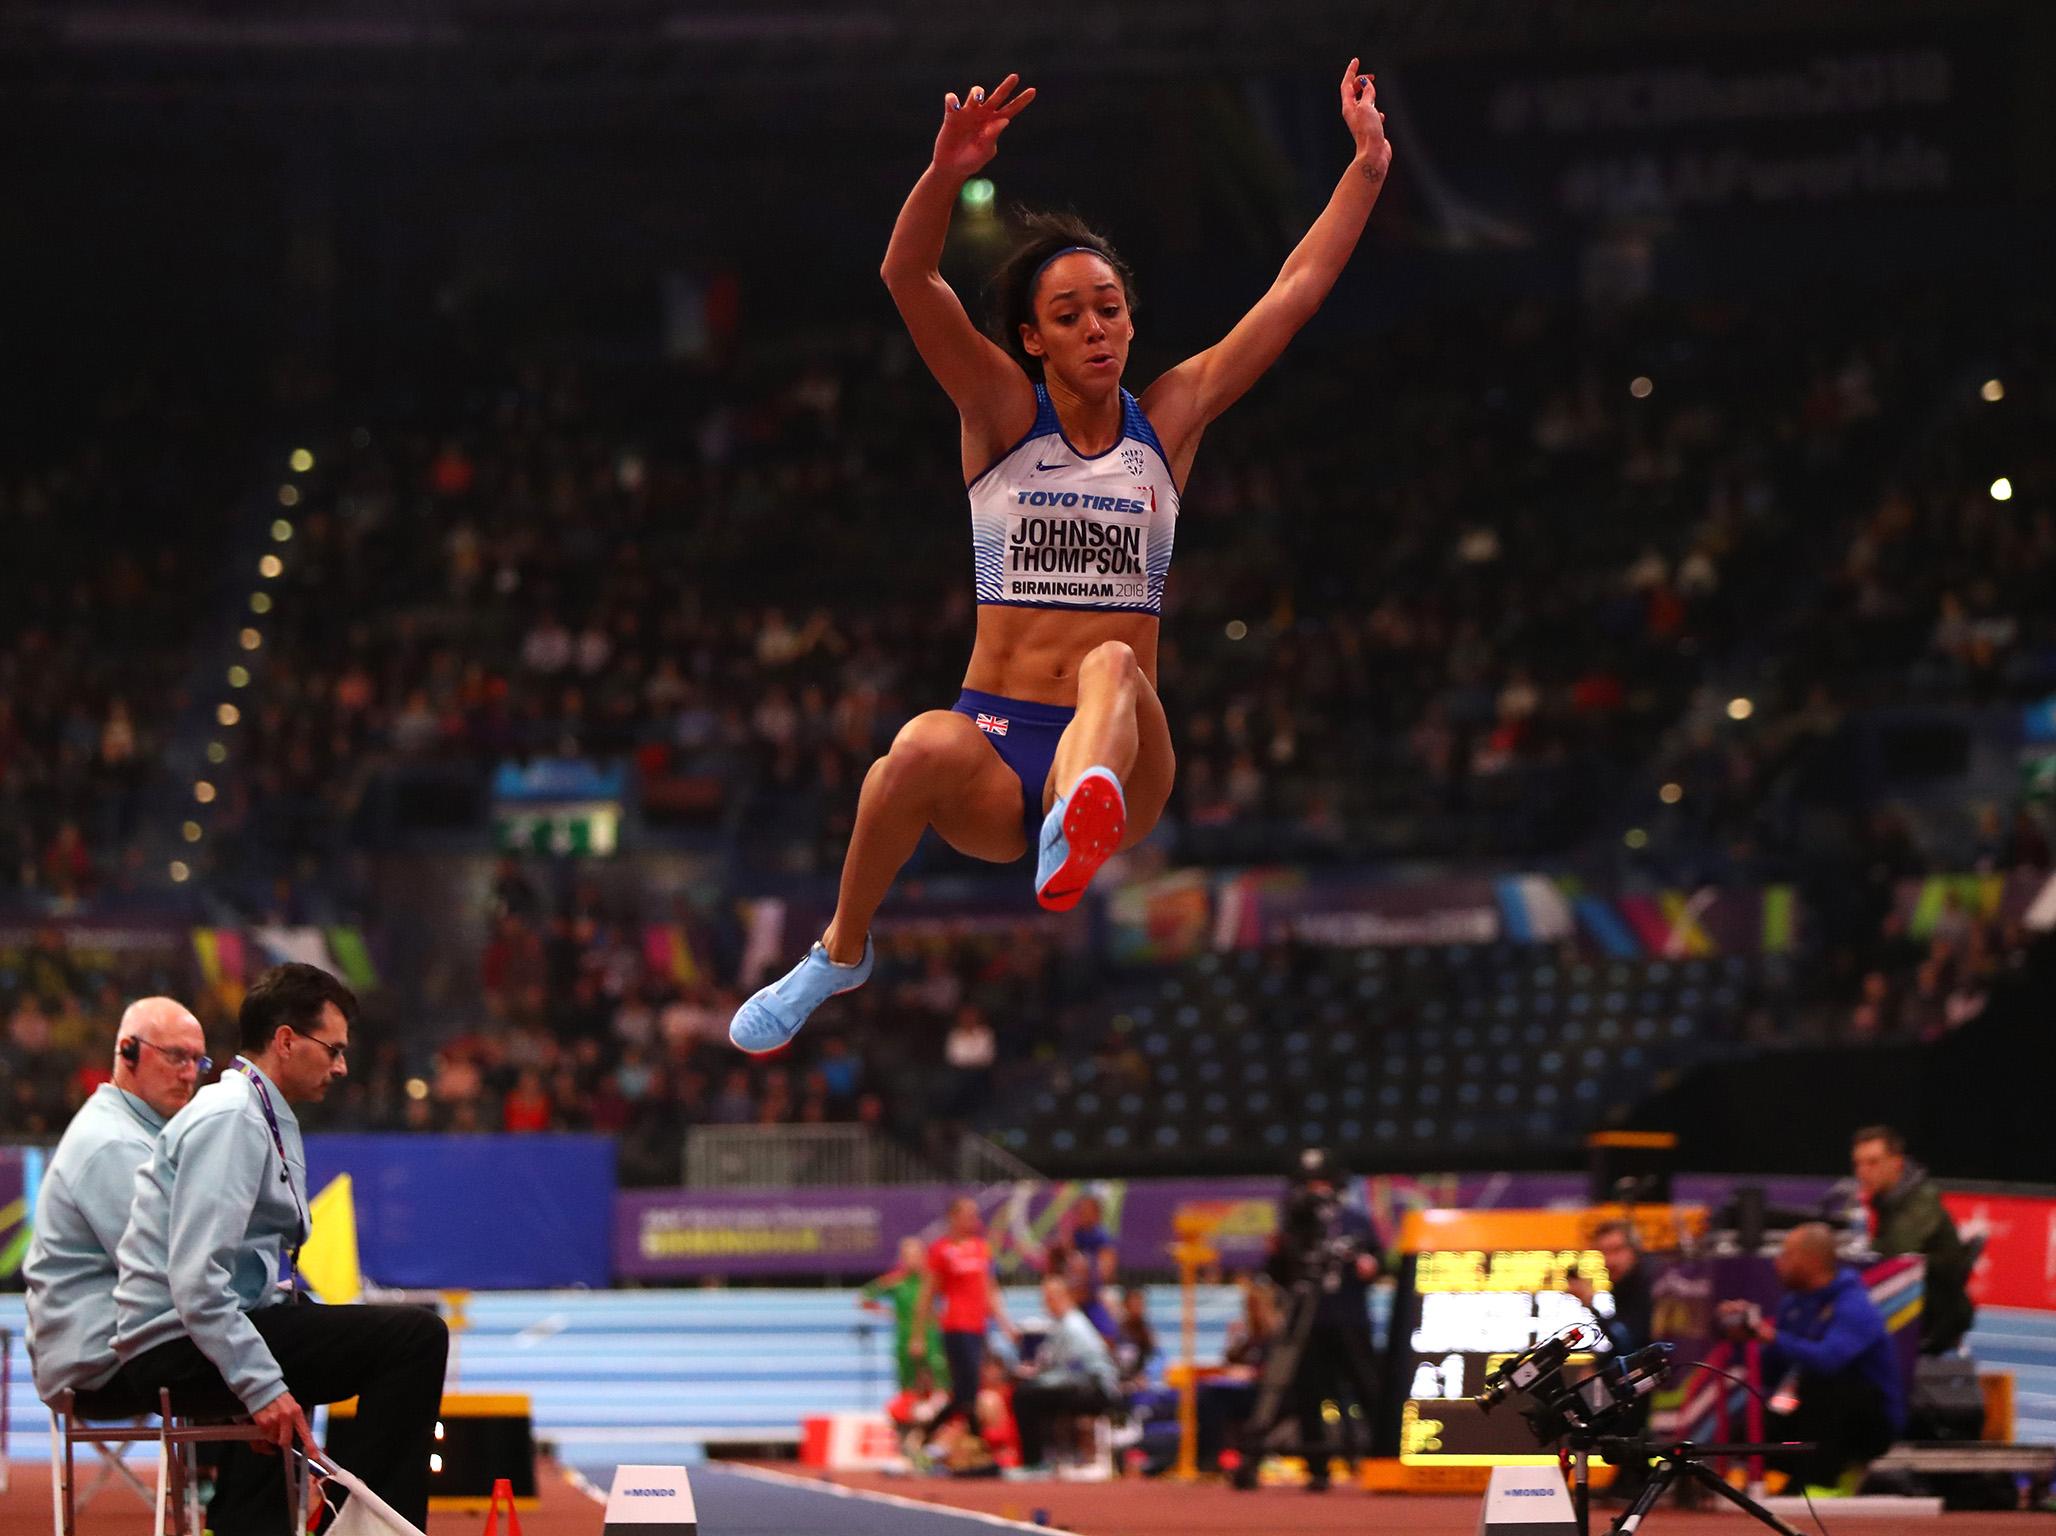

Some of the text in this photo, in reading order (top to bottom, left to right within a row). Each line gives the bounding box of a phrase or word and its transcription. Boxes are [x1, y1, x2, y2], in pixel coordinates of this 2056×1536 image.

[1018, 491, 1146, 514] TOYO TIRES
[1011, 517, 1141, 556] JOHNSON
[1010, 545, 1142, 575] THOMPSON
[1012, 581, 1144, 598] BIRMINGHAM 2018
